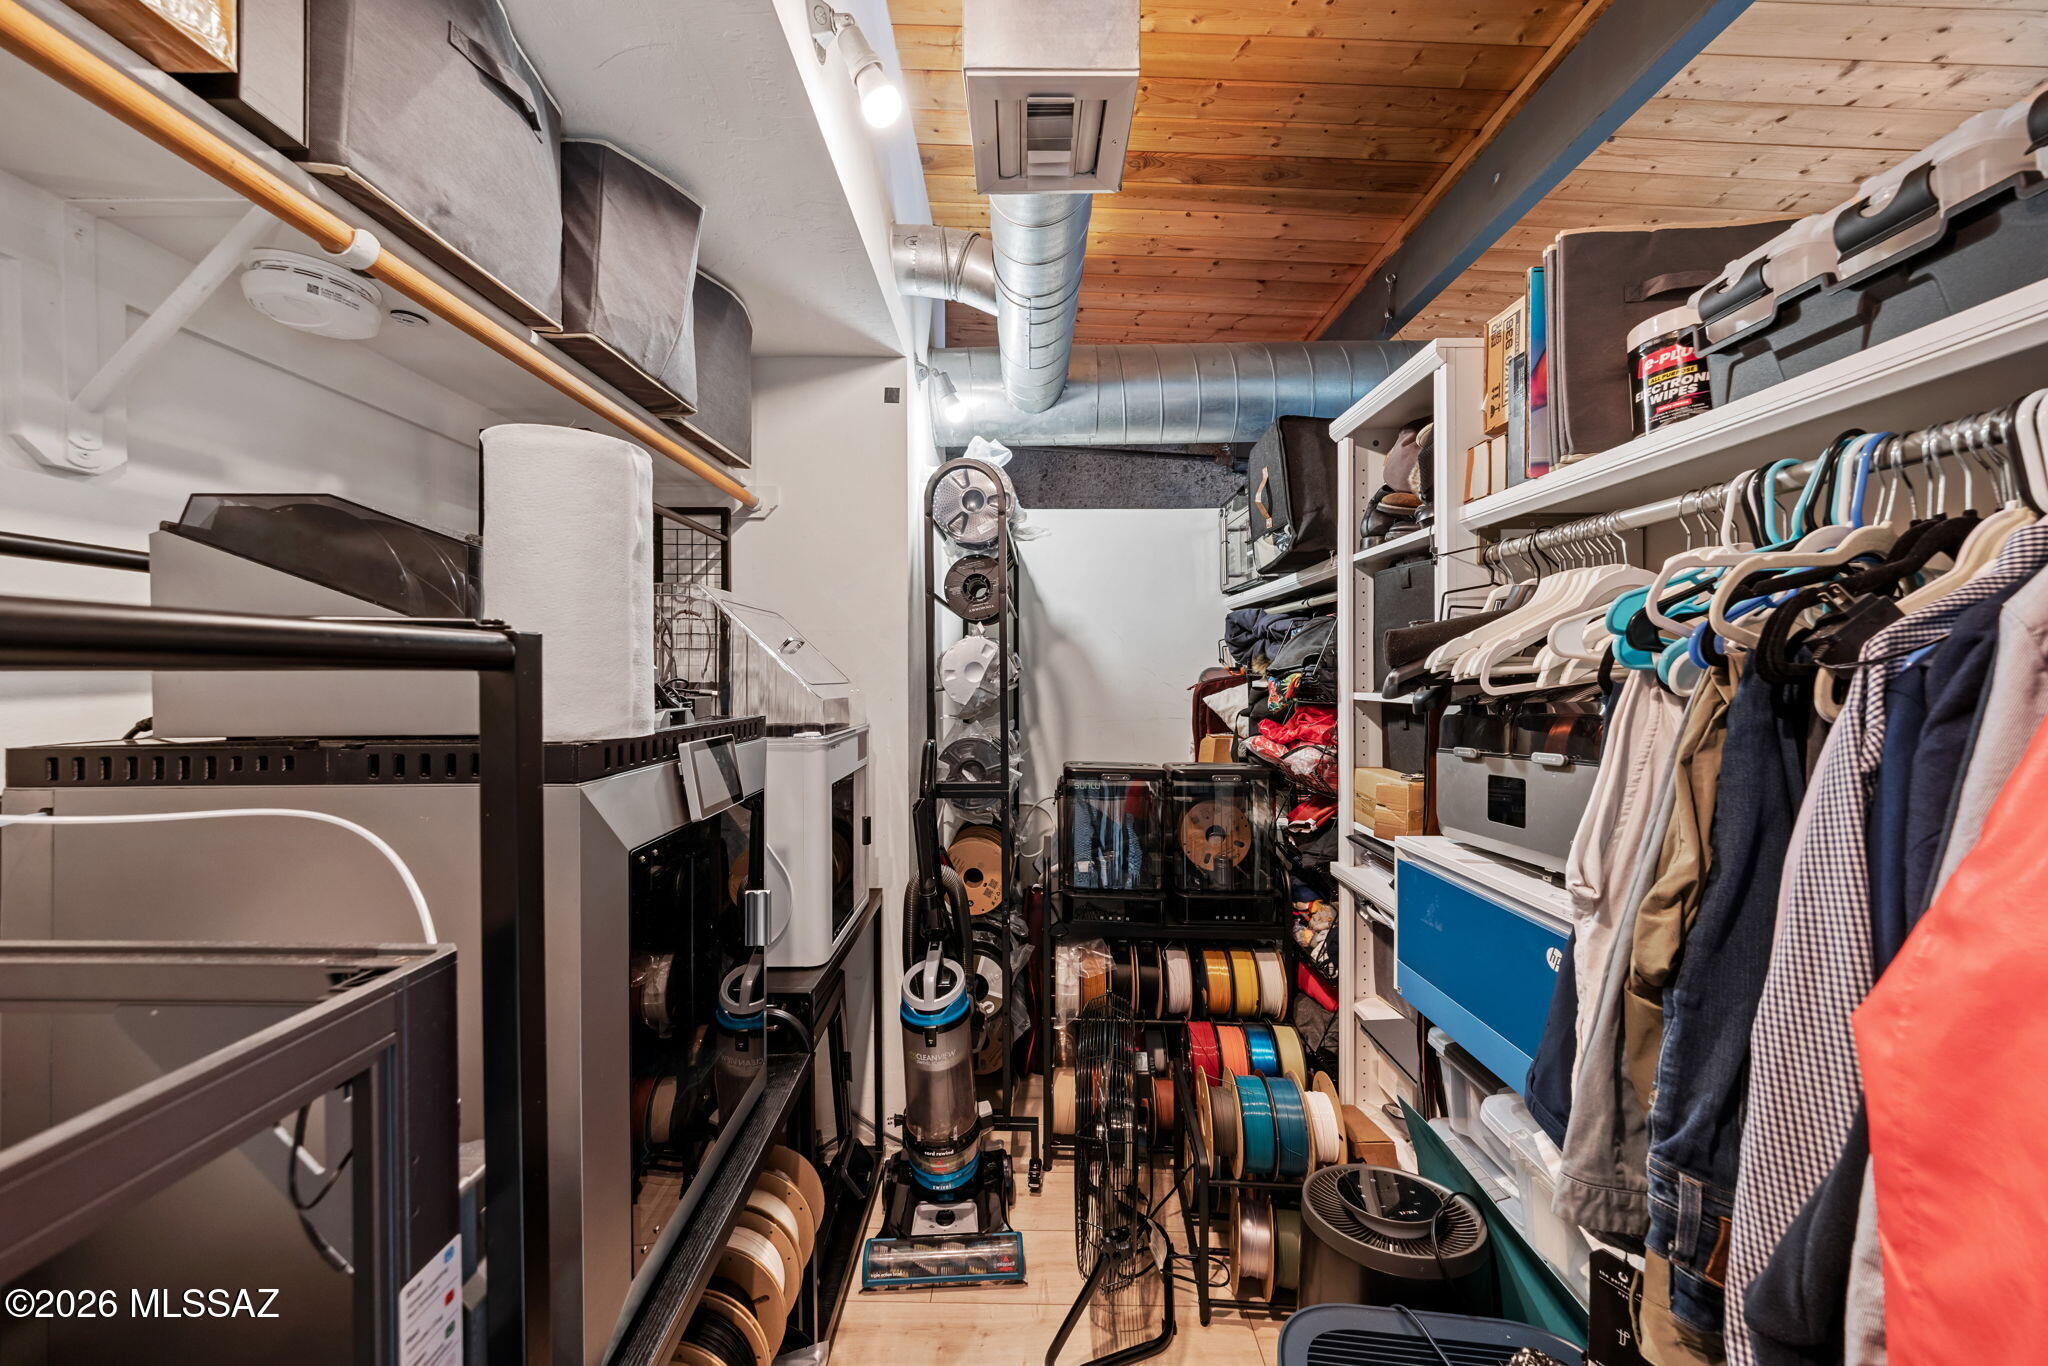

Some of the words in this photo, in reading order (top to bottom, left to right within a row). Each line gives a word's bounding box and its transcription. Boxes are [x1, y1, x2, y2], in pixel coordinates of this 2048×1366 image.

[1505, 317, 1514, 350] 936
[1644, 346, 1696, 370] e-PLU
[1635, 371, 1710, 404] ELECTRONI
[1650, 376, 1661, 385] ALL
[1649, 383, 1699, 405] WIPES
[916, 1049, 957, 1062] CLEANVIEW
